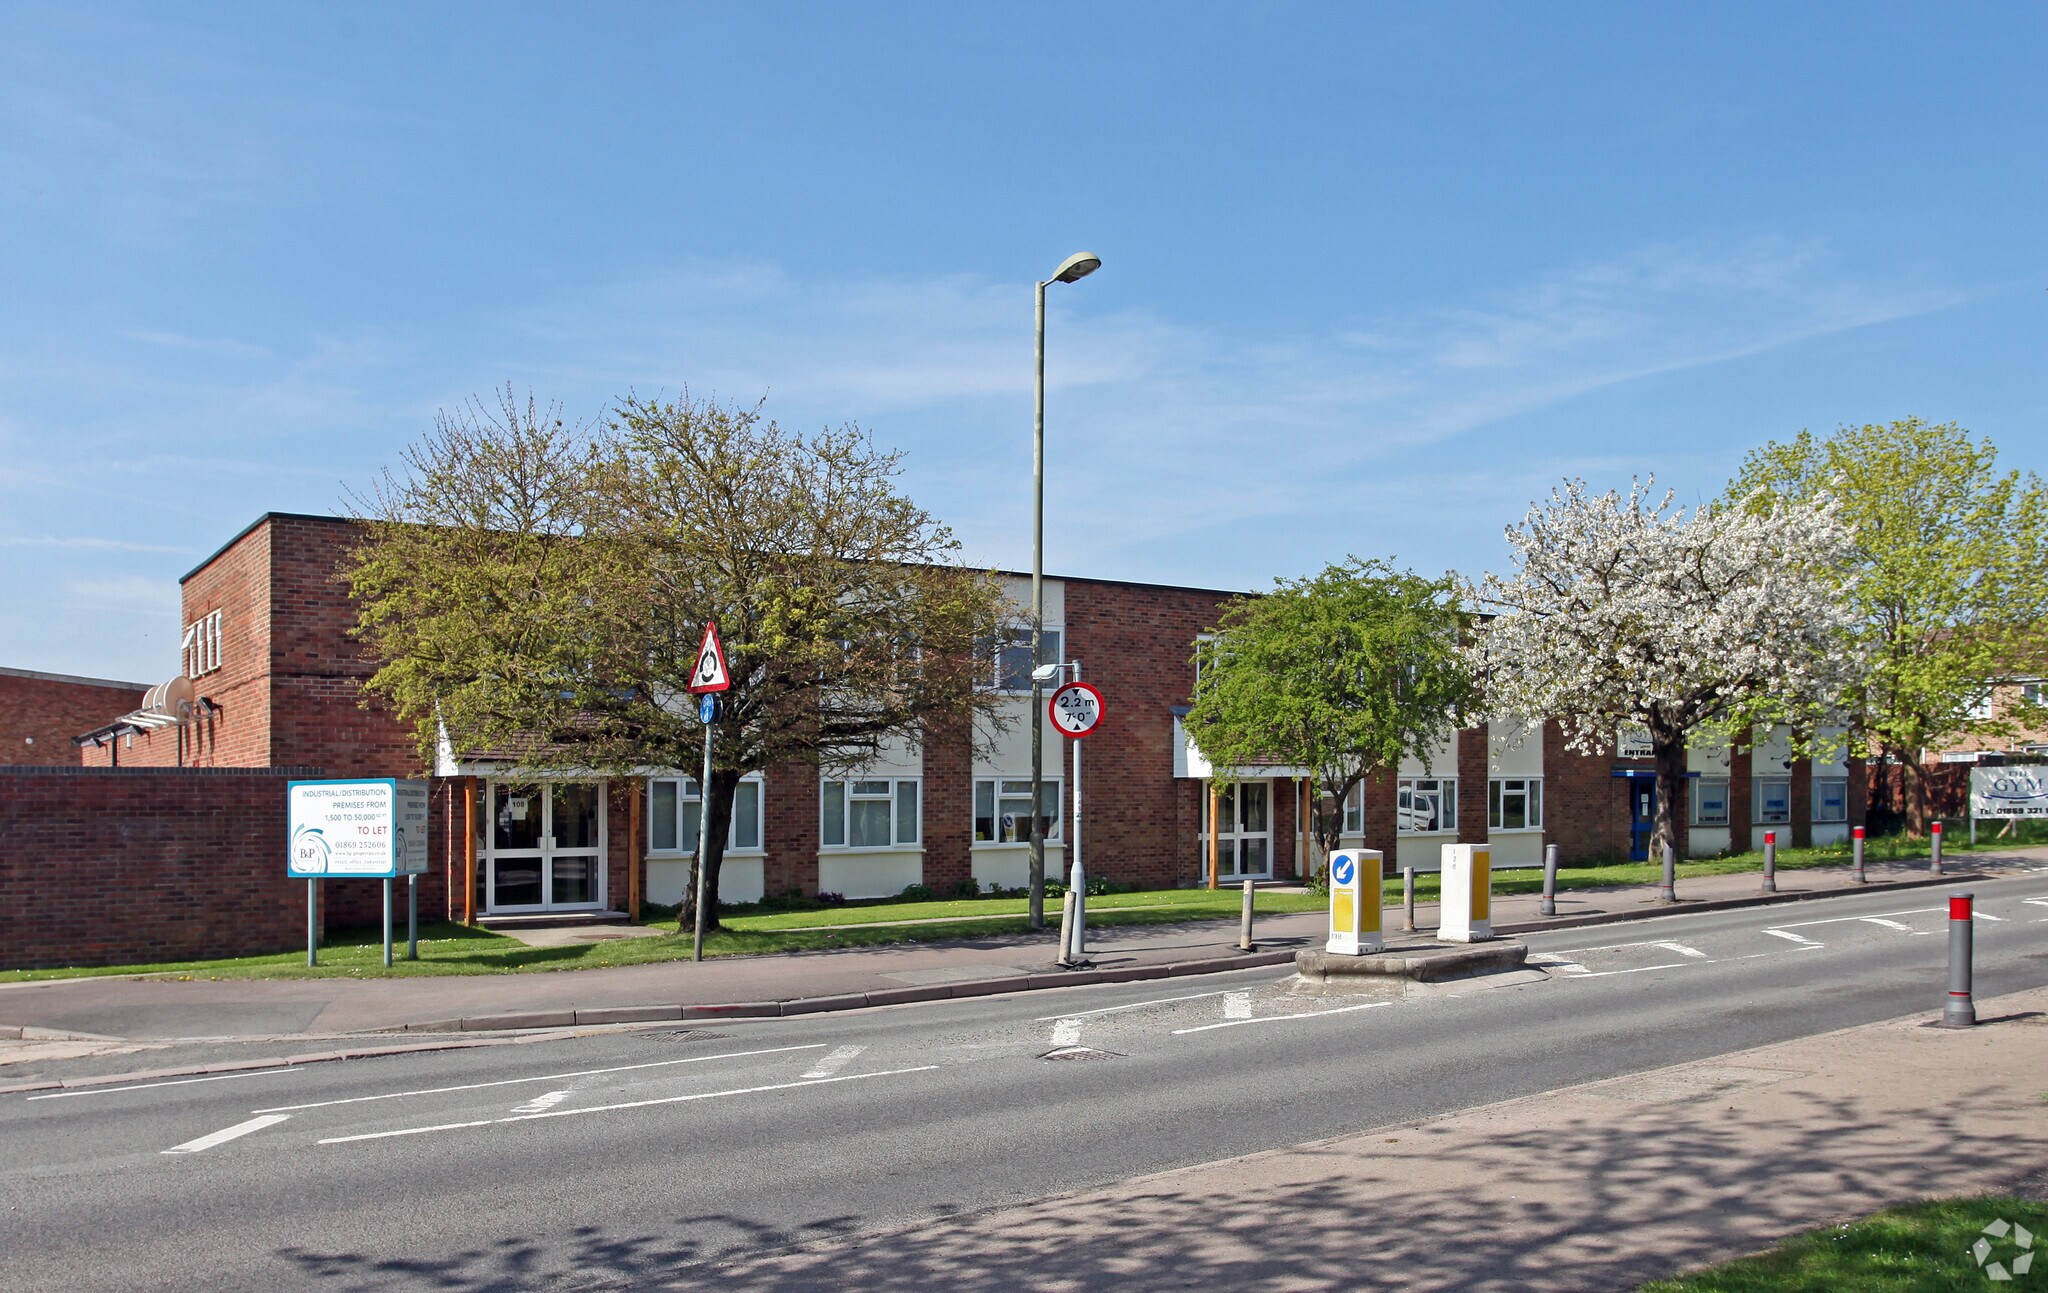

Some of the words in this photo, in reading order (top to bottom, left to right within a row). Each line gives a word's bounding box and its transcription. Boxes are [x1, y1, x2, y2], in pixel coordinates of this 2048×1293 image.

[1060, 696, 1081, 708] 2.2
[1084, 699, 1095, 707] m
[1994, 778, 2044, 792] GYM
[302, 788, 386, 798] INDUSTRIAL/DISTRIBUTION
[333, 801, 365, 809] PREMISES
[366, 801, 387, 809] FROM
[324, 813, 342, 822] 1,500
[343, 813, 353, 821] TO
[354, 813, 376, 822] 50,000
[358, 826, 370, 835] TO
[372, 826, 388, 835] LET
[335, 841, 357, 849] 01869
[359, 841, 386, 849] 252606
